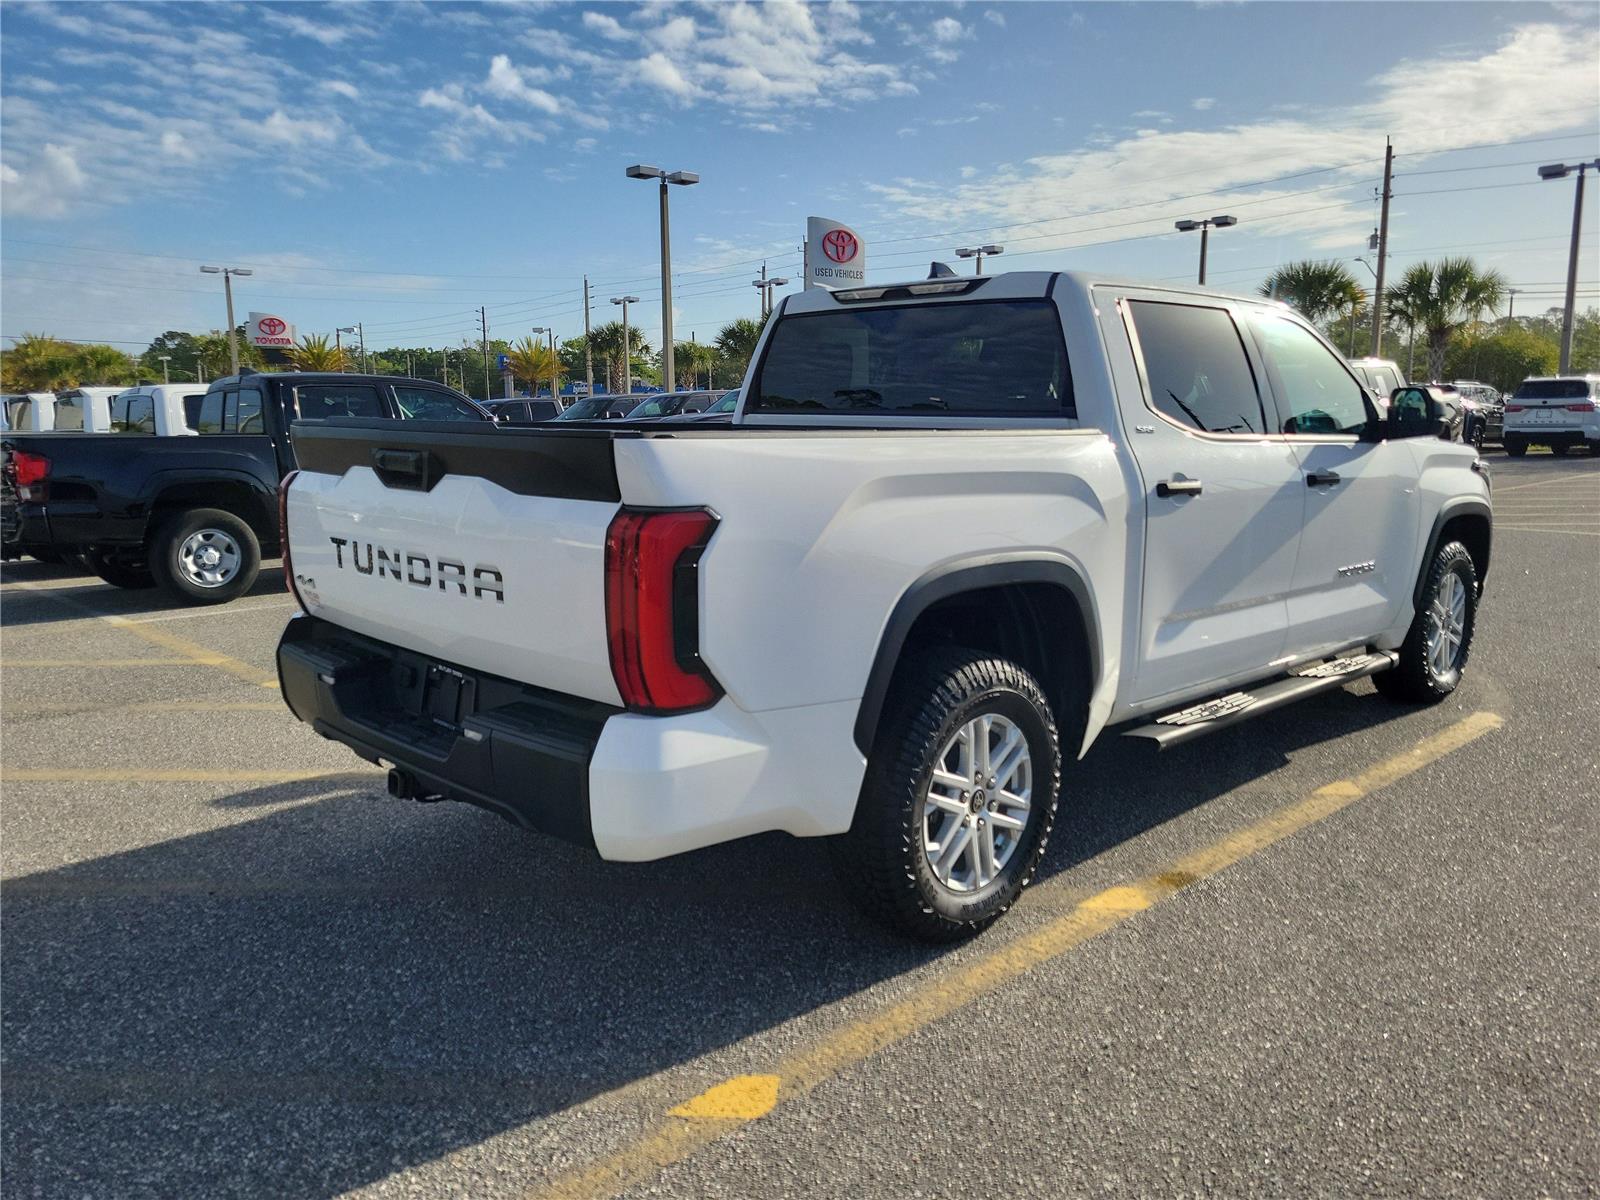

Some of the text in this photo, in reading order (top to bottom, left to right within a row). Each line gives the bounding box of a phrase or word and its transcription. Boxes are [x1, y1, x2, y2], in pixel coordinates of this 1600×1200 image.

[815, 267, 864, 280] USED VEHICLES
[254, 336, 292, 345] TOYOTA
[329, 536, 505, 604] TUNDRA
